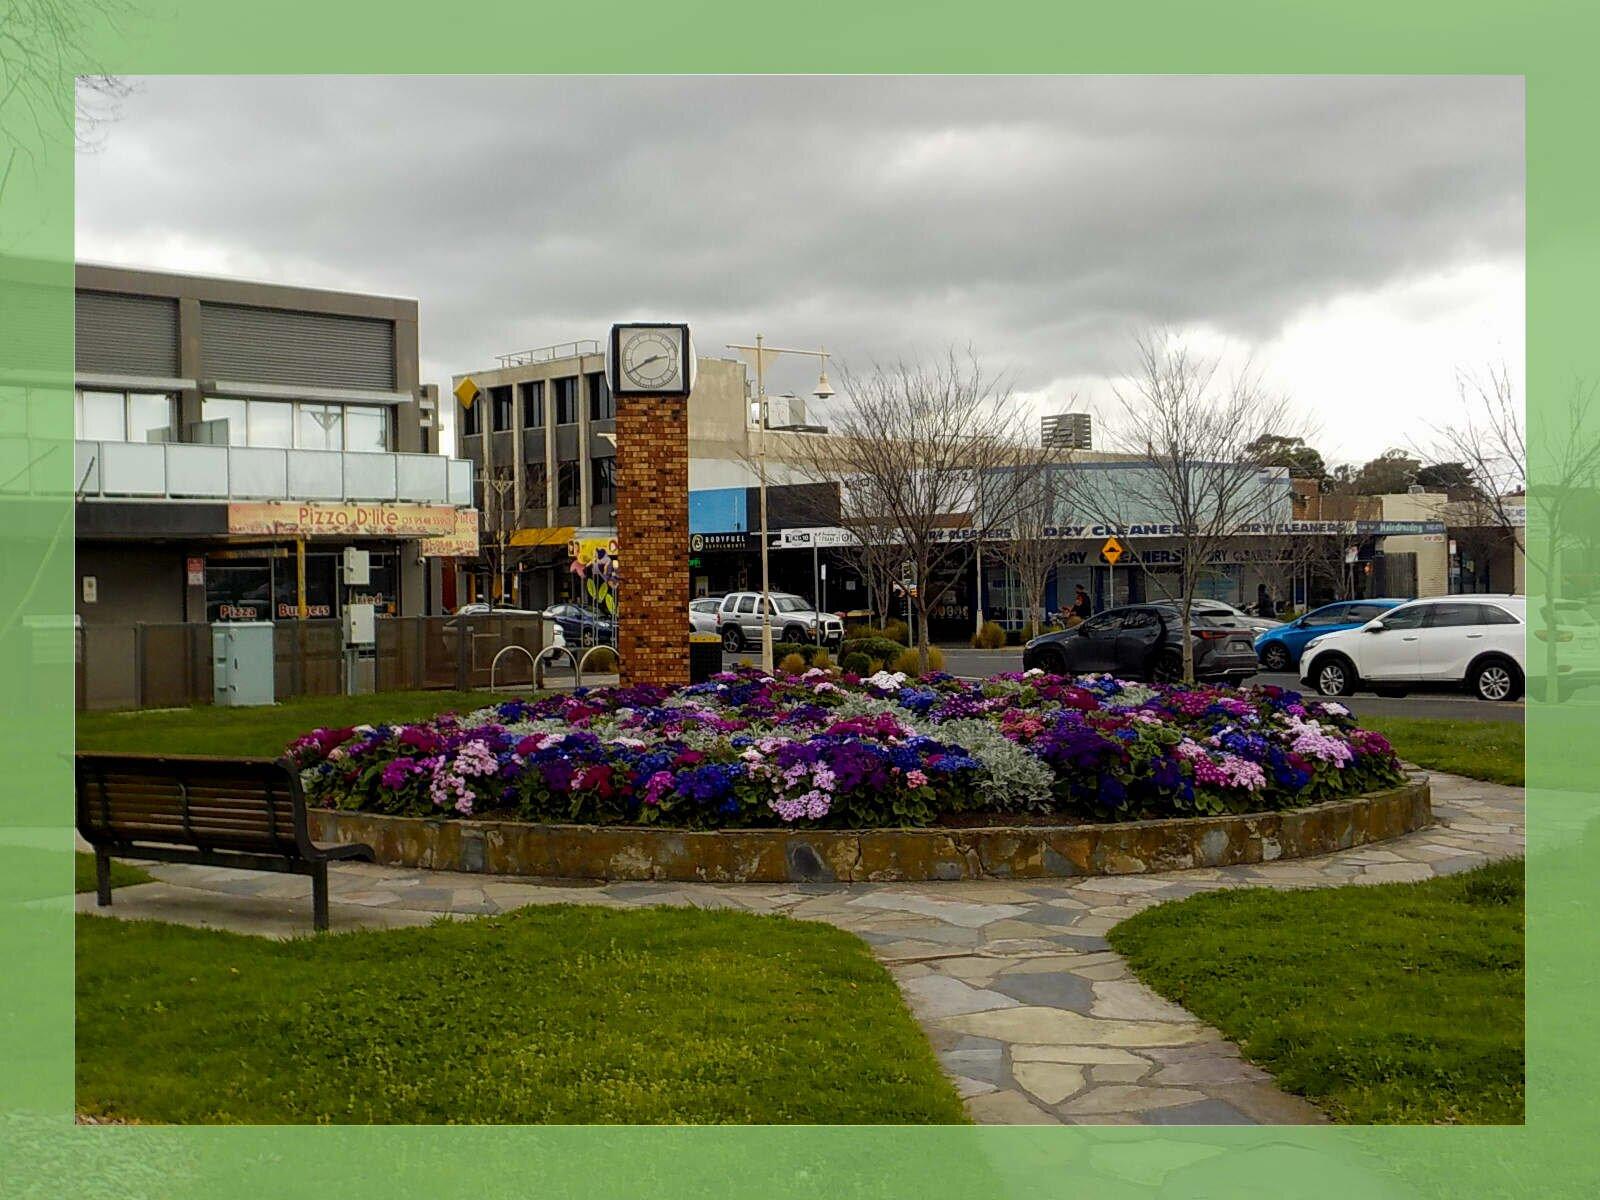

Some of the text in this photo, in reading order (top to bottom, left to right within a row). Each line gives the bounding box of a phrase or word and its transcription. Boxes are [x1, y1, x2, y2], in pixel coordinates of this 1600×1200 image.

[299, 506, 348, 525] Pizza
[1043, 526, 1086, 537] DRY
[1098, 549, 1182, 564] CEANERS
[220, 604, 257, 619] Pizza
[279, 603, 330, 618] Bugers
